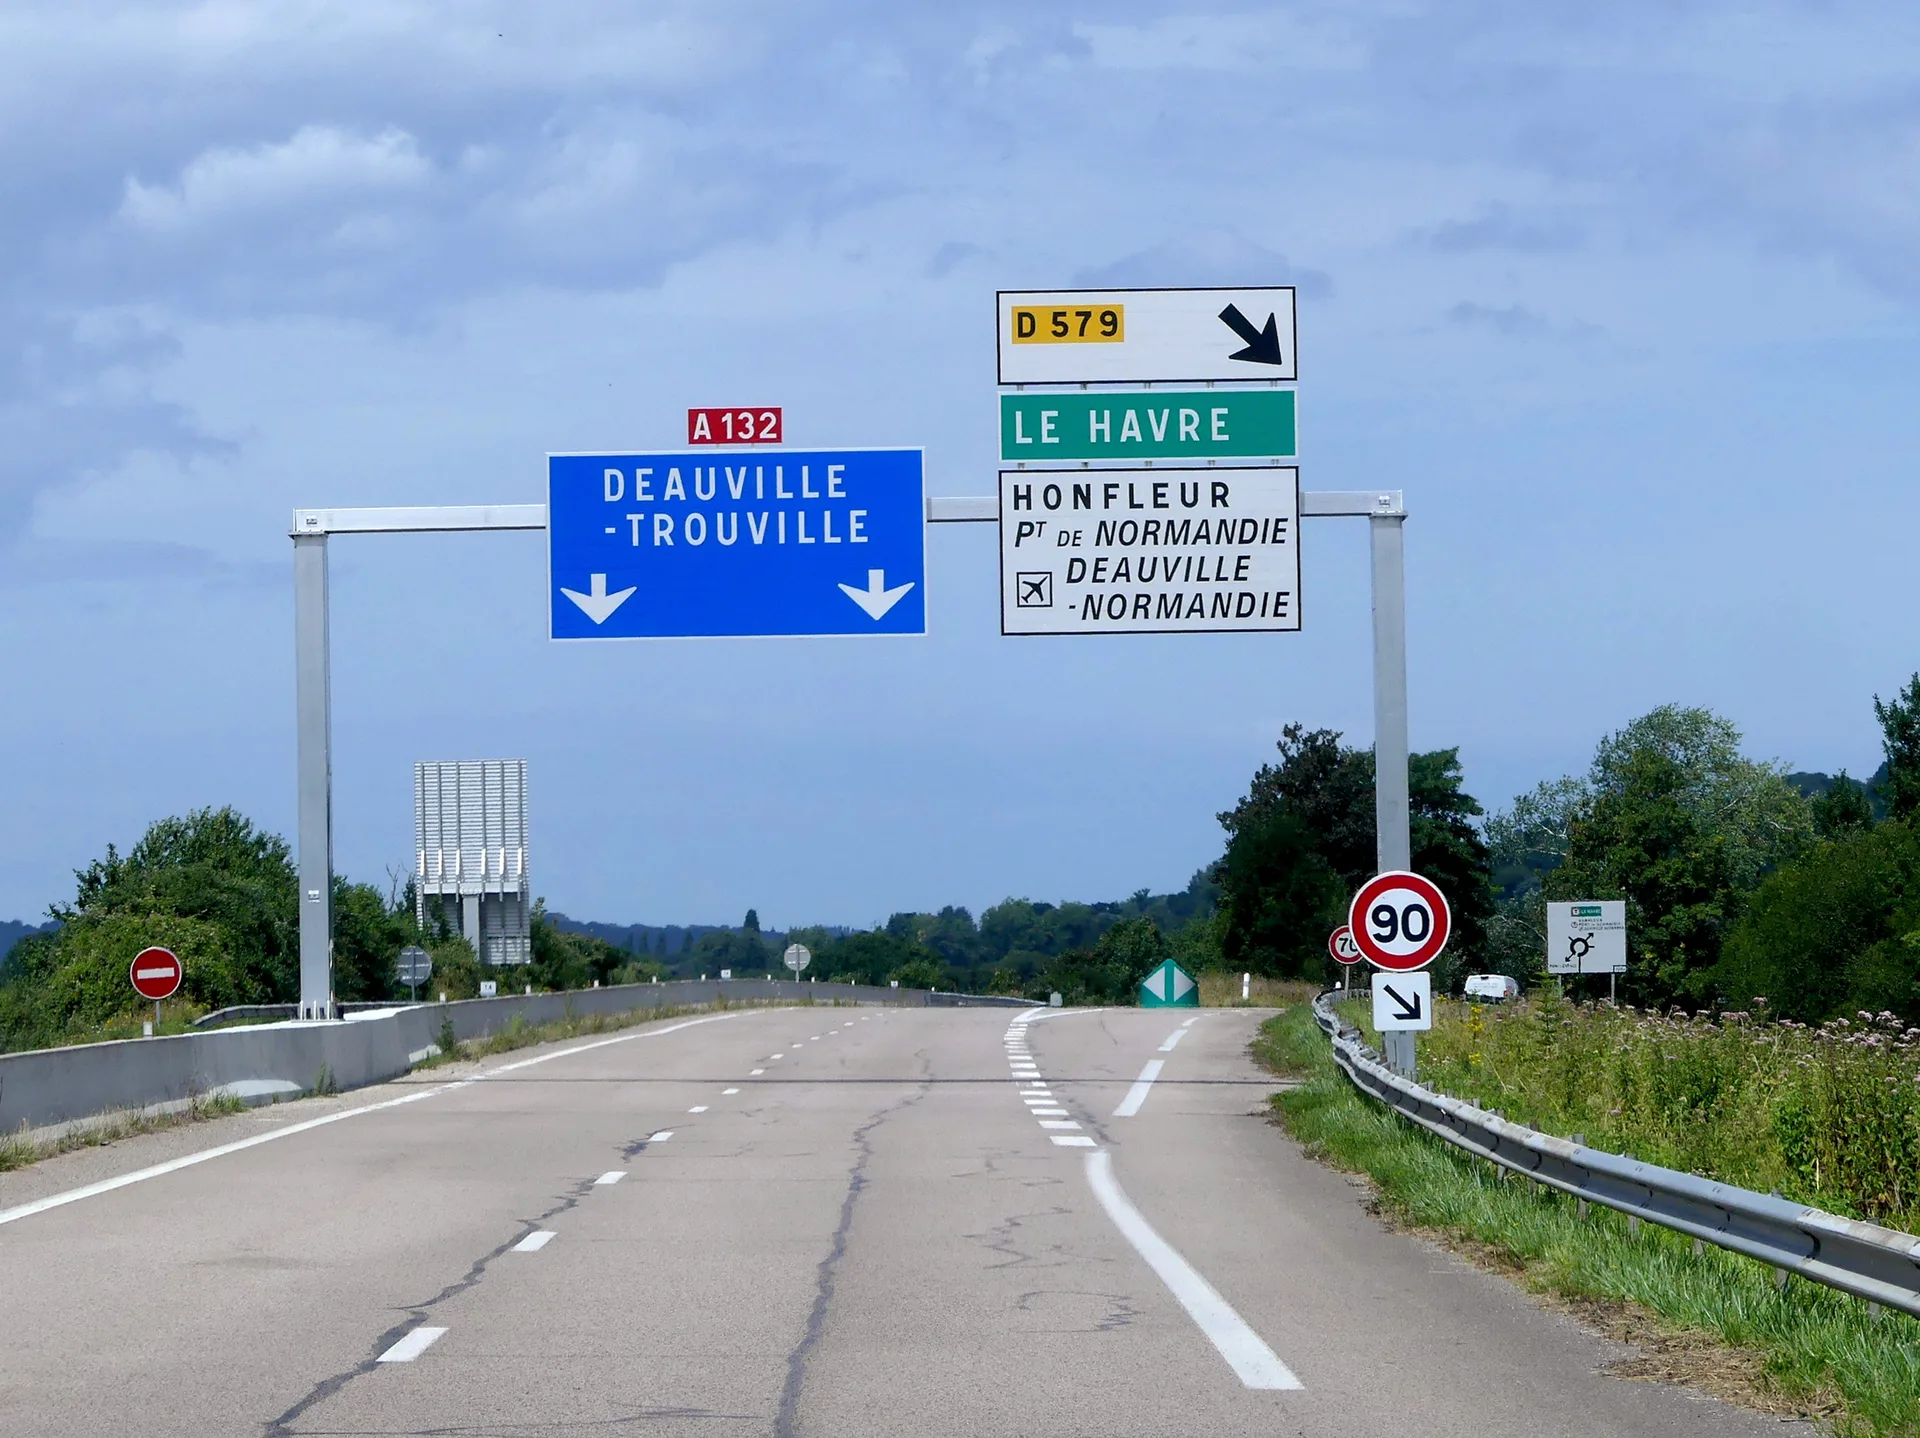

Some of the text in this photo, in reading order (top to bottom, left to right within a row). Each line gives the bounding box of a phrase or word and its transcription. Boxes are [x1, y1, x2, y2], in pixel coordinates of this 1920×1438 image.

[1016, 310, 1119, 338] D 579
[693, 412, 778, 440] A 132
[1015, 408, 1230, 444] LE HAVRE
[604, 464, 847, 502] DEAUVILLE
[1013, 482, 1231, 511] HONFLEUR
[604, 510, 869, 547] -TROUVILLE
[1057, 530, 1082, 547] DE
[1095, 518, 1289, 547] NORMANDIE
[1066, 555, 1252, 584] DEAUVILLE
[1069, 591, 1290, 620] -NORMANDIE
[1371, 903, 1430, 944] 90
